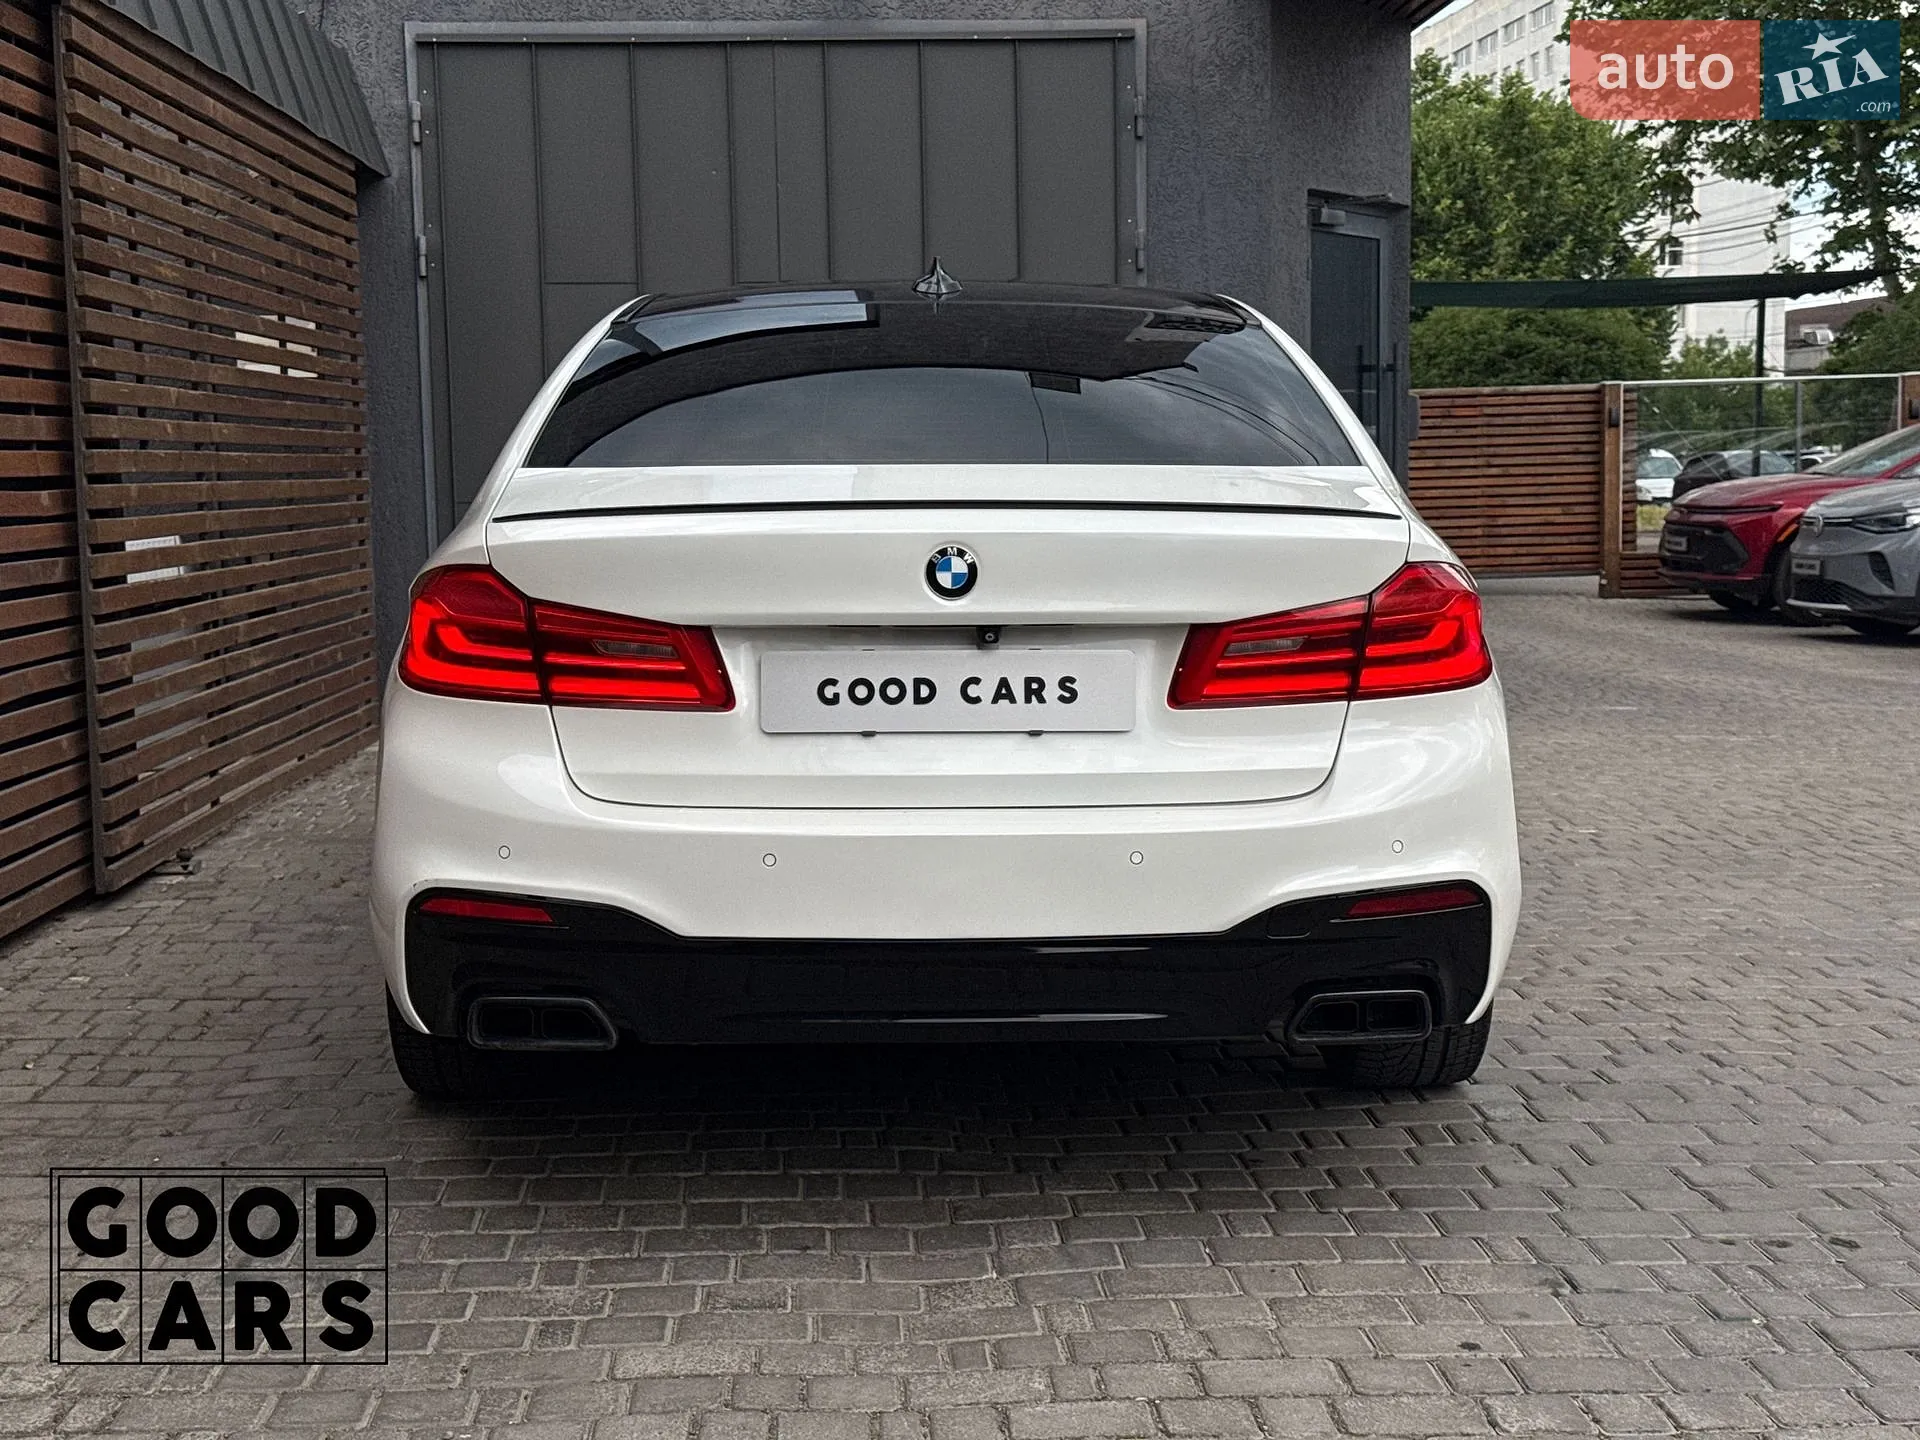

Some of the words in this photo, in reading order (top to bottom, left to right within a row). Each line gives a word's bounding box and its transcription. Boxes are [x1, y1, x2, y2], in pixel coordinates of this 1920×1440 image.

[931, 546, 975, 564] BMW
[816, 677, 937, 706] GOOD
[959, 675, 1079, 705] CARS
